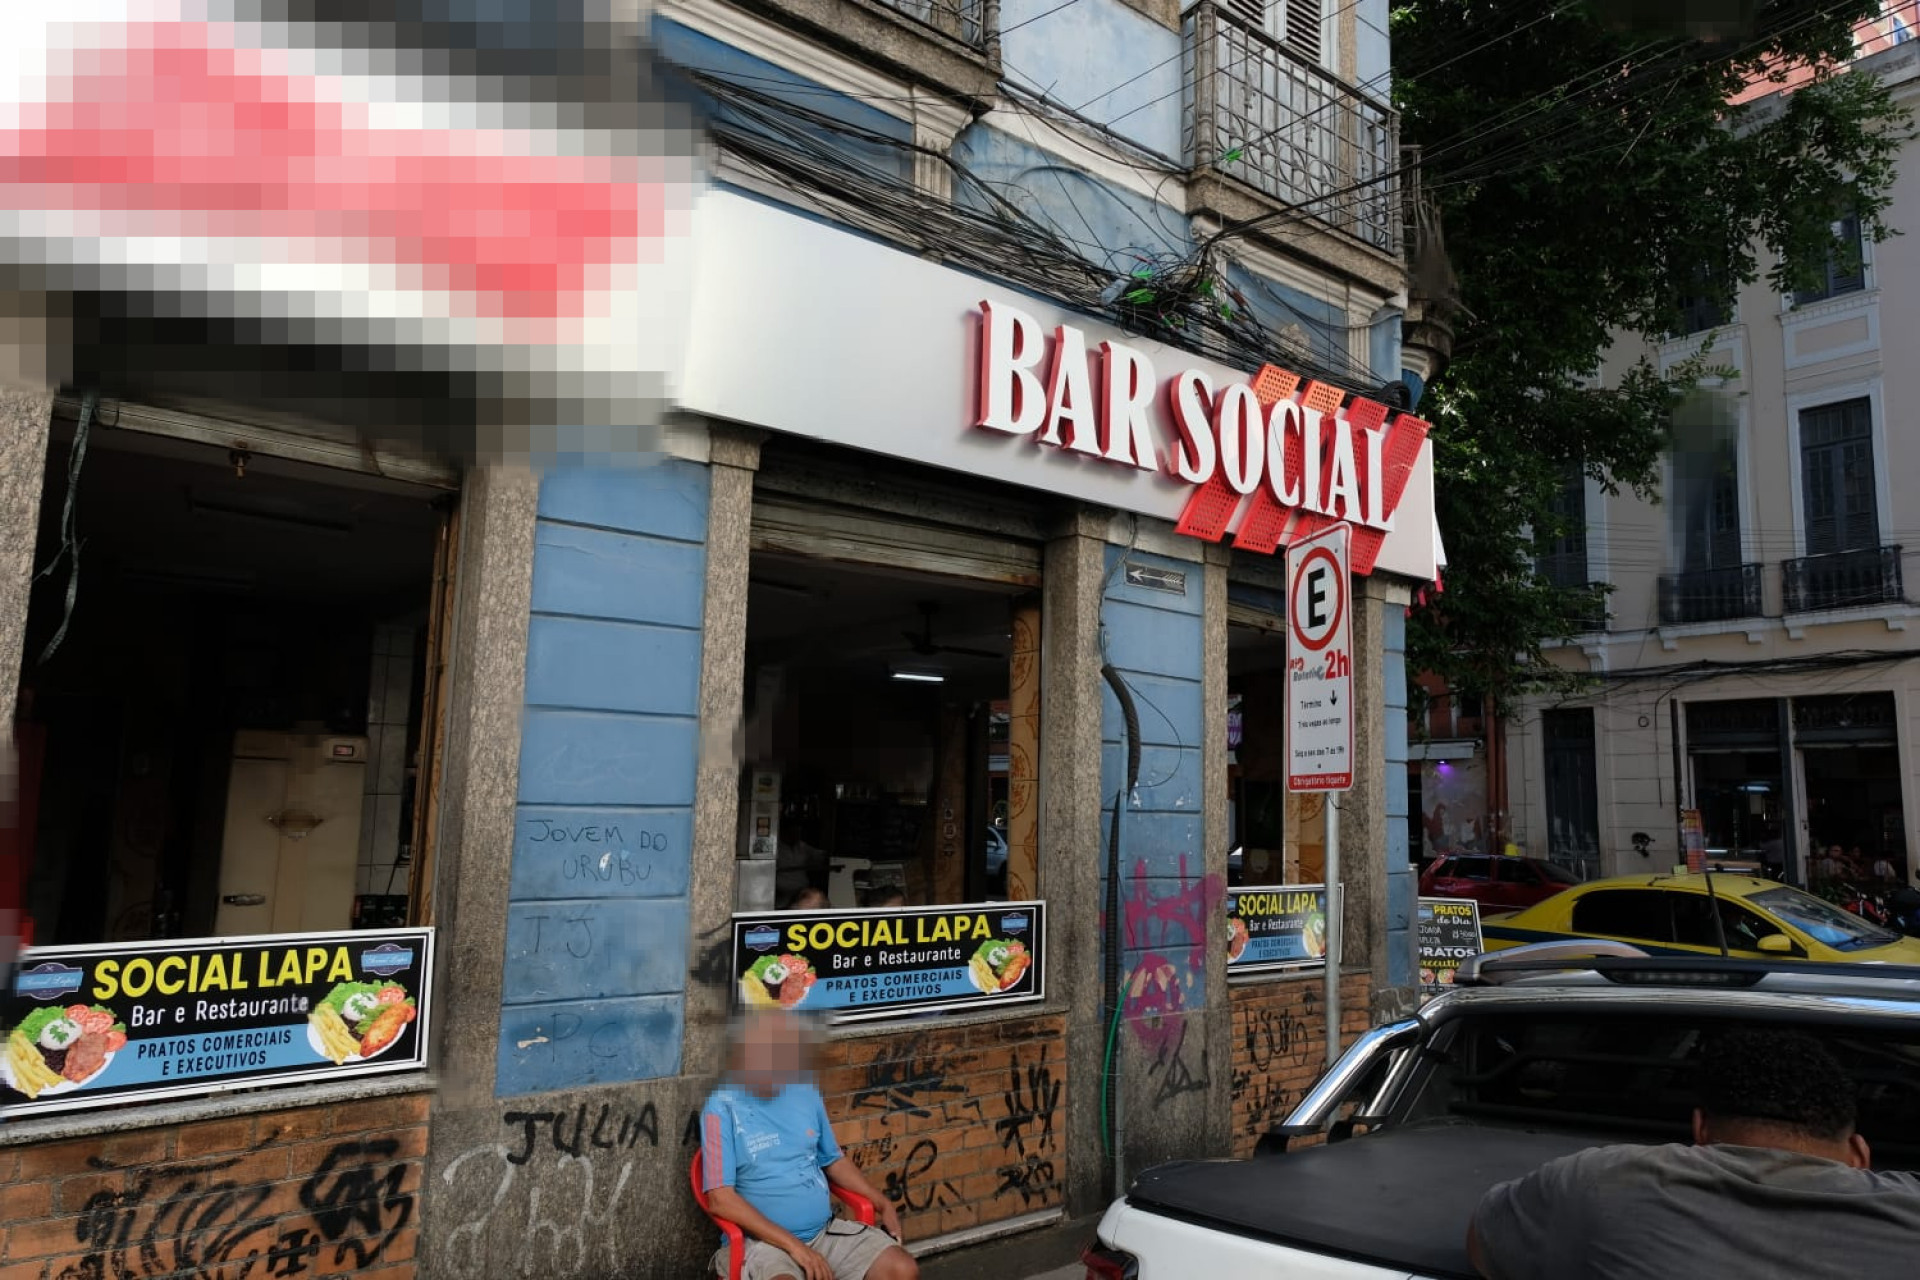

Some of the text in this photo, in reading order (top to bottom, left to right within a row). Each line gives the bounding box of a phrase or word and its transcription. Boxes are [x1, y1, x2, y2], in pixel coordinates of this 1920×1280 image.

[977, 300, 1396, 533] BAR SOCIAL
[1308, 567, 1326, 628] E
[1325, 649, 1349, 680] 2h
[526, 819, 624, 844] JOVEM
[1238, 891, 1317, 916] SOCIAL LAPA
[1433, 905, 1472, 916] PRATOS
[786, 918, 910, 952] SOCIAL
[917, 913, 992, 943] LAPA
[92, 946, 353, 1000] SOCIAL LAPA
[832, 946, 961, 970] Bar e Restaurante
[826, 968, 963, 992] PRATOS COMERCIAIS
[850, 983, 942, 1002] E EXECUTIVOS
[131, 993, 309, 1028] Bar e Restaurante
[137, 1029, 292, 1060] PRATOS COMERCIAIS
[162, 1055, 267, 1076] E EXECUTIVOS
[504, 1103, 659, 1165] JULIA
